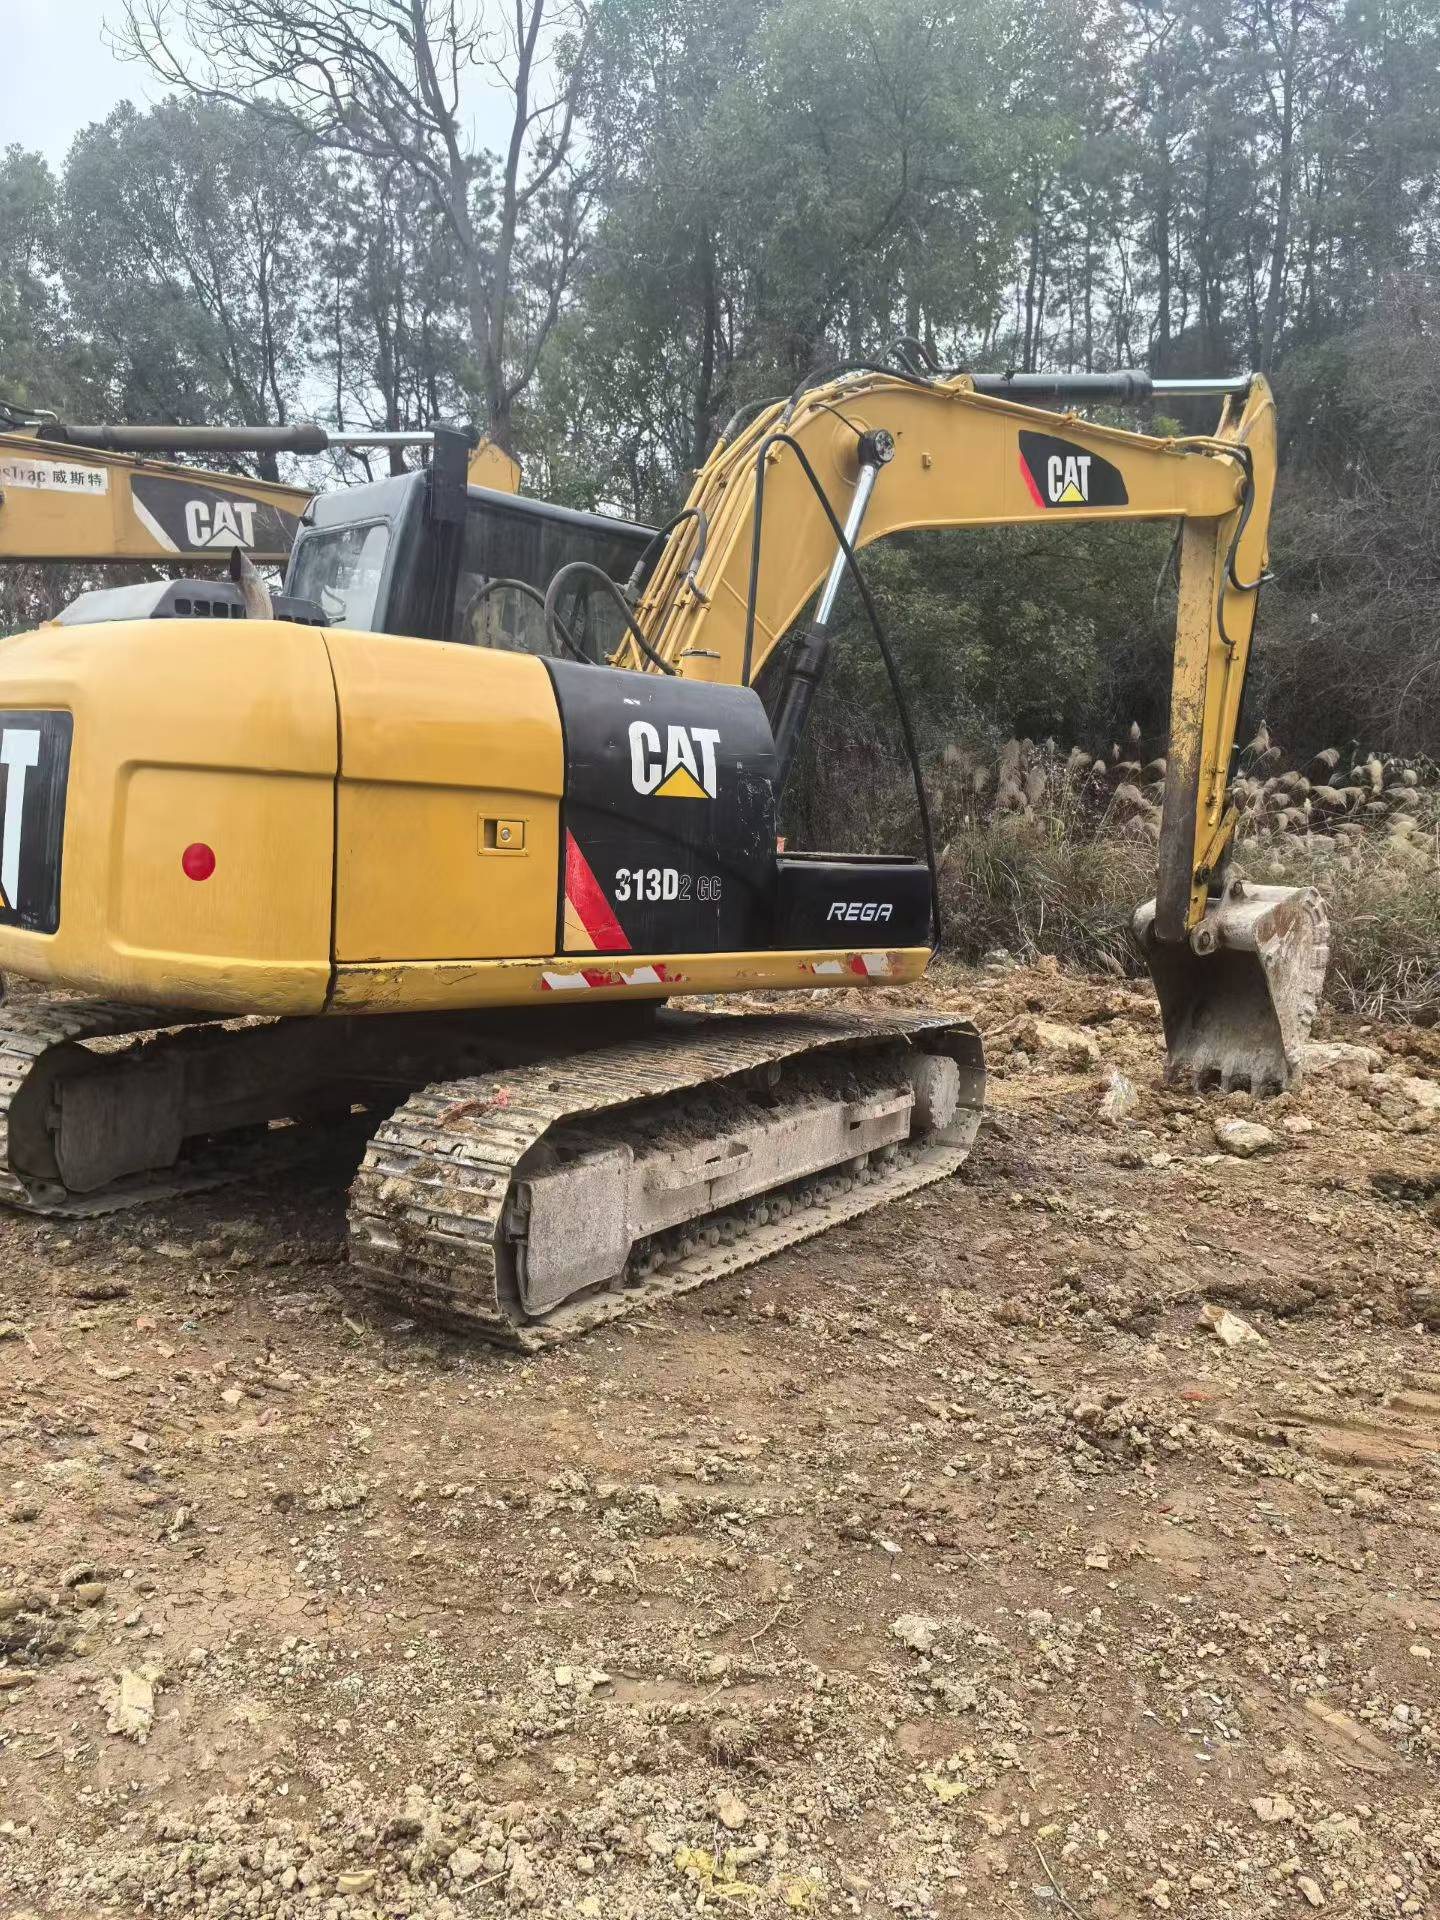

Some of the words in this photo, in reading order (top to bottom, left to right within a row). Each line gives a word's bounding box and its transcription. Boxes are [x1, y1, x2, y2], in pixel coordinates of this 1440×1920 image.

[0, 465, 46, 484] sTrac
[53, 469, 103, 487] 威斯特
[1047, 455, 1091, 503] CAT
[185, 500, 257, 548] CAT
[628, 720, 721, 799] CAT
[697, 875, 722, 901] GC
[826, 902, 893, 921] REGA
